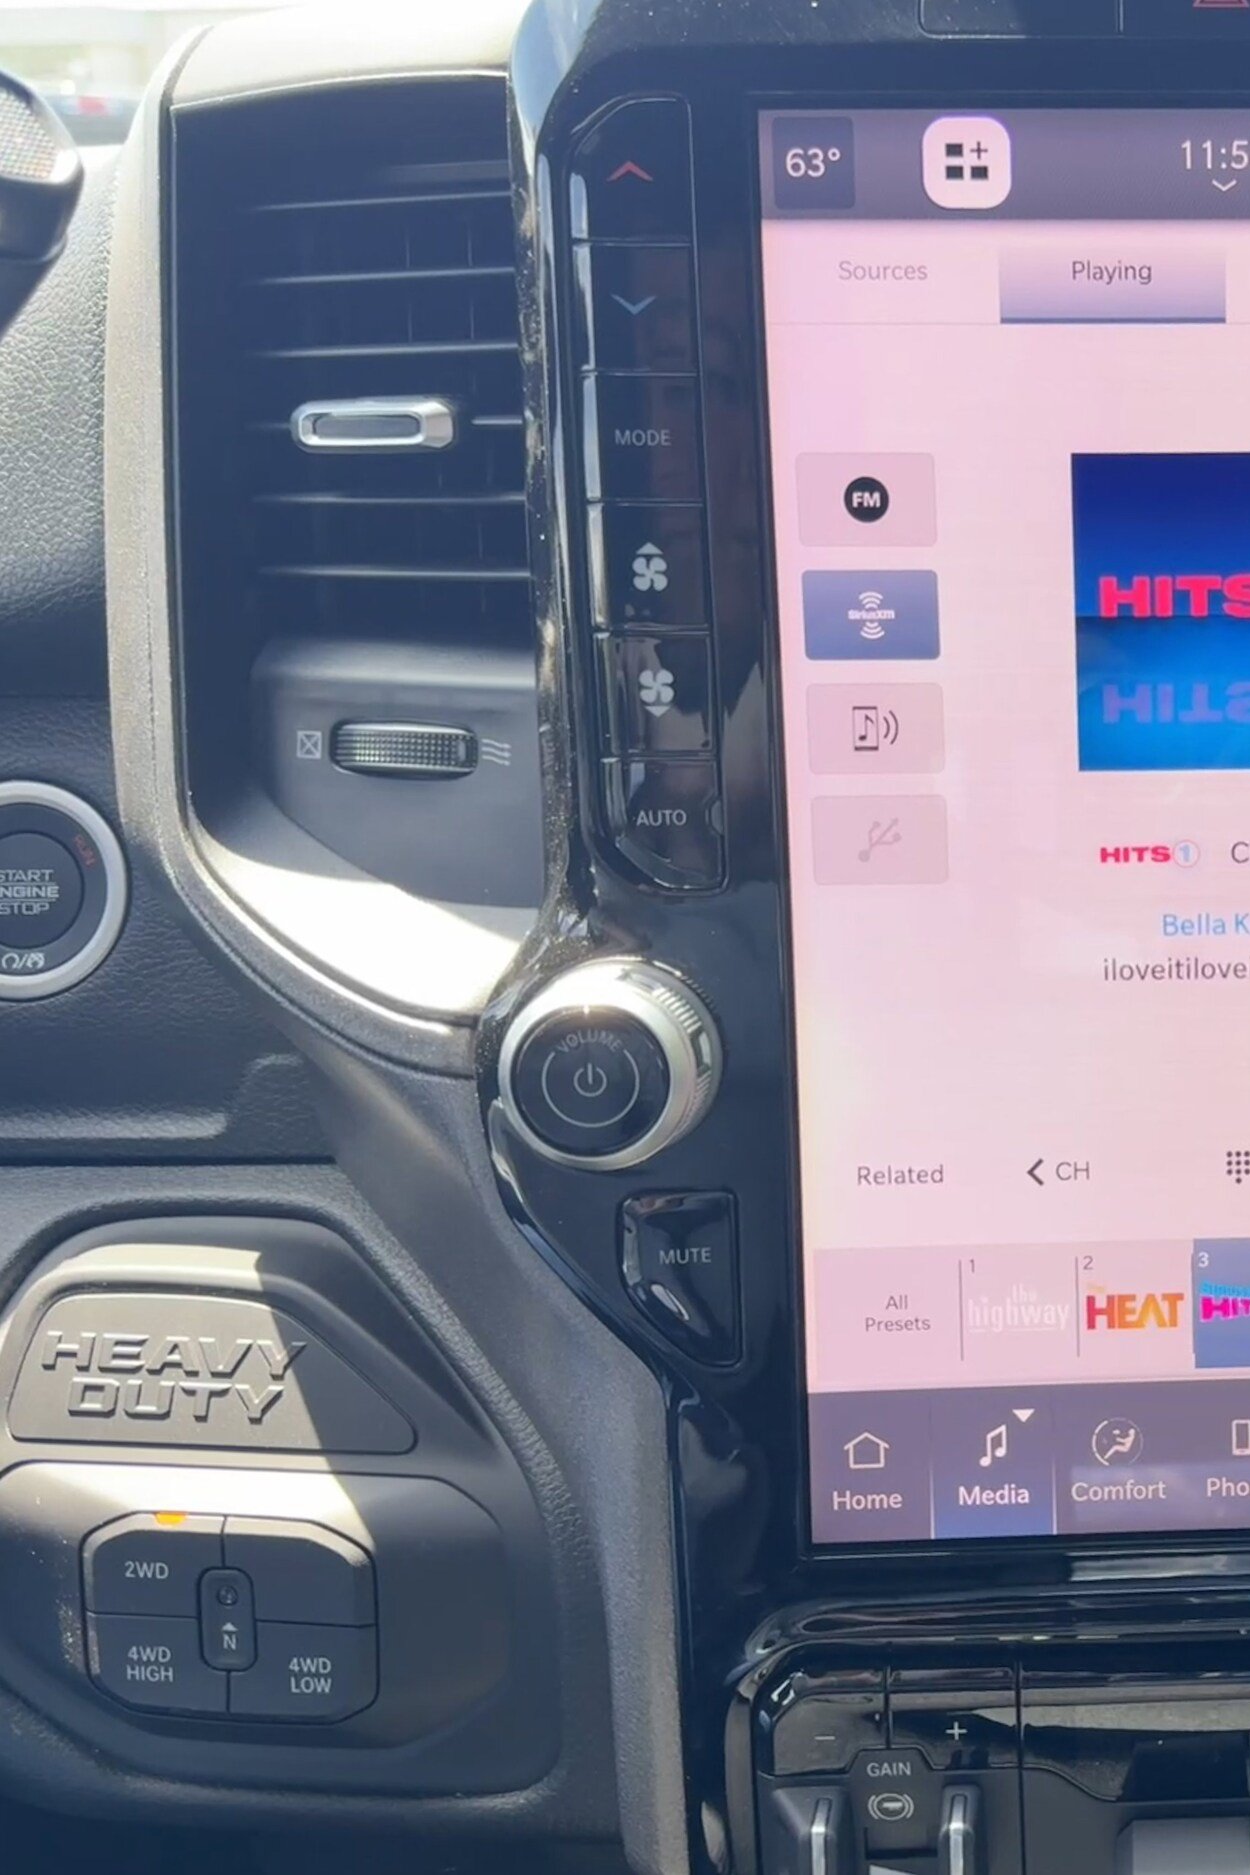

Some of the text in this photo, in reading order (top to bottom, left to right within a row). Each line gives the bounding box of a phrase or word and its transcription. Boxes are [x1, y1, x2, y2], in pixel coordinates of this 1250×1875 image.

[785, 147, 841, 178] 63°
[837, 260, 928, 282] Sources
[1071, 260, 1153, 285] Playing
[614, 429, 672, 447] MODE
[851, 491, 881, 508] FM
[635, 809, 687, 827] AUTO
[1100, 846, 1171, 863] HITS
[0, 886, 60, 898] NGINE
[0, 902, 50, 915] STOP
[1161, 913, 1226, 937] Bella
[554, 1029, 623, 1054] VOLUME
[856, 1165, 944, 1186] Related
[1055, 1161, 1091, 1182] CH
[658, 1247, 712, 1266] MUTE
[969, 1258, 976, 1273] 1
[1082, 1255, 1094, 1271] 2
[1198, 1251, 1209, 1268] 3
[885, 1295, 909, 1310] All
[1086, 1293, 1185, 1330] HEAT
[968, 1296, 1070, 1332] highway
[865, 1315, 931, 1333] Presets
[41, 1330, 308, 1380] HEAVY
[67, 1375, 287, 1425] DUTY
[957, 1484, 1030, 1506] Media
[1071, 1479, 1167, 1502] Comfort
[832, 1490, 903, 1511] Home
[124, 1561, 169, 1580] 2WD
[222, 1633, 237, 1651] N
[127, 1646, 171, 1663] 4WD
[126, 1665, 174, 1682] HIGH
[288, 1657, 332, 1675] 4WD
[290, 1676, 332, 1694] LOW
[867, 1761, 912, 1777] GAIN
